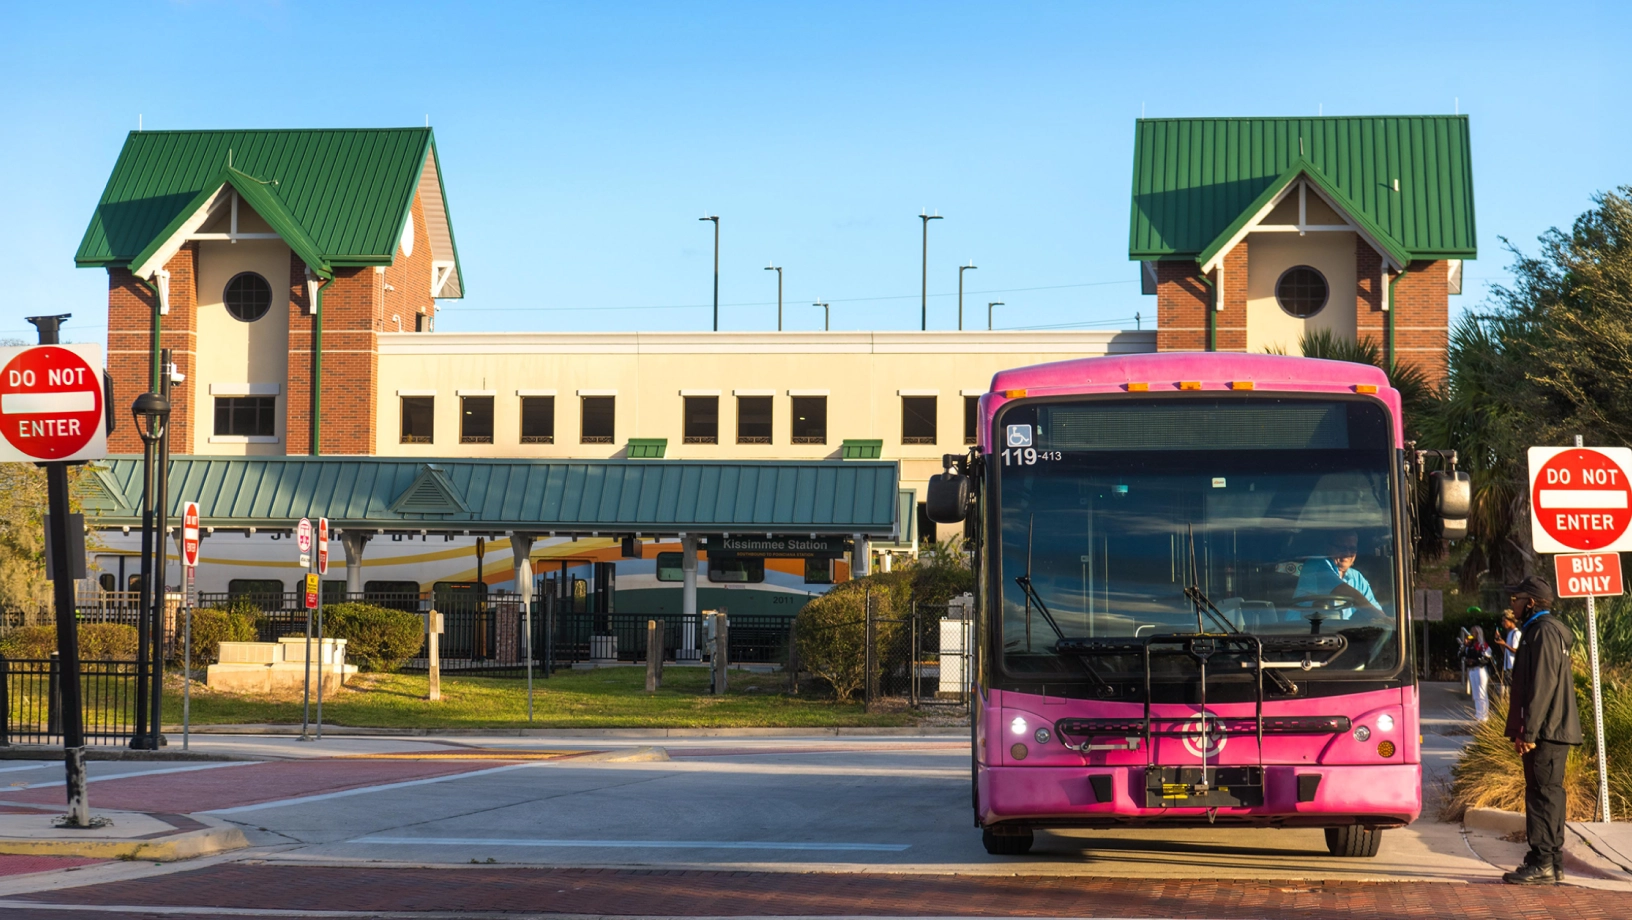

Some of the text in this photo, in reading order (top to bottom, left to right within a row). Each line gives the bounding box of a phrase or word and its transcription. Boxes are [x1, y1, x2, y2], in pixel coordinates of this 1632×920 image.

[9, 367, 86, 387] DO NOT
[19, 418, 81, 438] ENTER
[1546, 468, 1619, 485] DO NOT
[1556, 513, 1615, 531] ENTER
[723, 539, 828, 550] Kissimmee Station
[1571, 556, 1604, 574] BUS
[1568, 575, 1611, 593] ONLY
[772, 596, 794, 604] 2011
